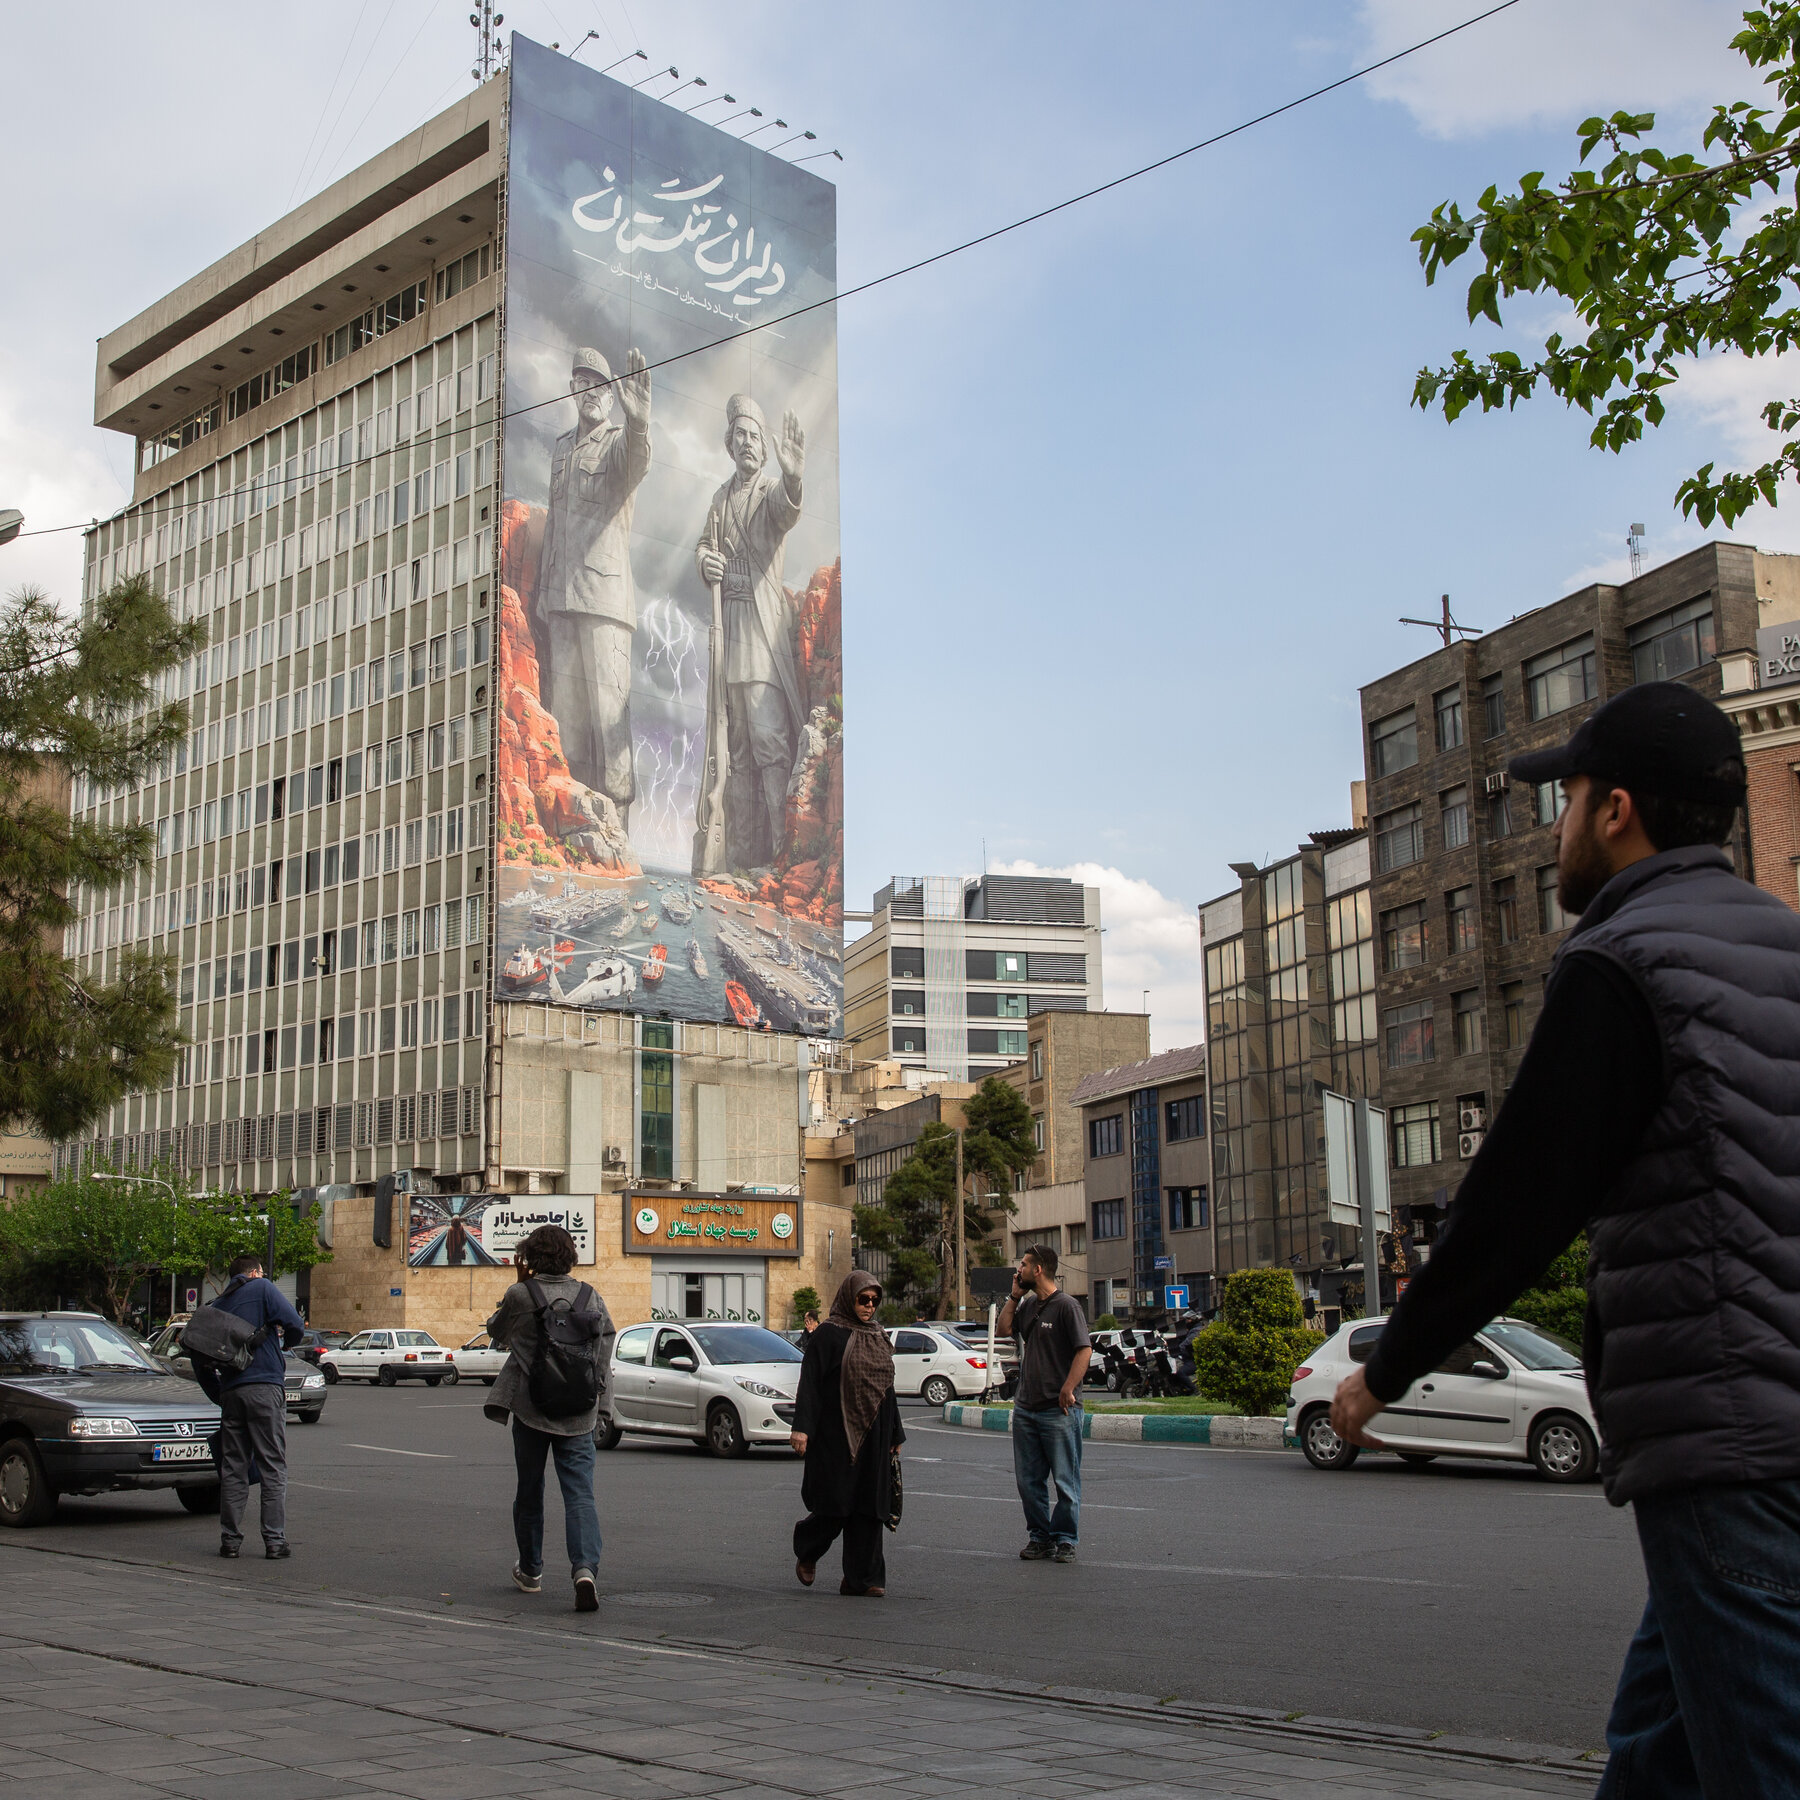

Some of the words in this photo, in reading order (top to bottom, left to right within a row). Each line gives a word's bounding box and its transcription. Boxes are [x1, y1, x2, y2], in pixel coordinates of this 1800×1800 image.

[572, 166, 725, 254] تنگستان
[695, 214, 786, 305] دلیران
[610, 262, 643, 283] ایران
[643, 272, 680, 296] تاریخ
[680, 290, 712, 311] دلیران
[713, 304, 734, 322] یاد
[18, 1151, 37, 1159] ایران
[682, 1202, 710, 1213] کشاورزی
[710, 1203, 724, 1215] جهاد
[725, 1203, 745, 1214] وزارت
[493, 1211, 525, 1228] بازار
[525, 1211, 565, 1227] جاهد
[492, 1229, 519, 1238] مستقیم
[667, 1219, 702, 1239] استقلال
[705, 1221, 727, 1241] جهاد
[729, 1225, 759, 1241] موسسه
